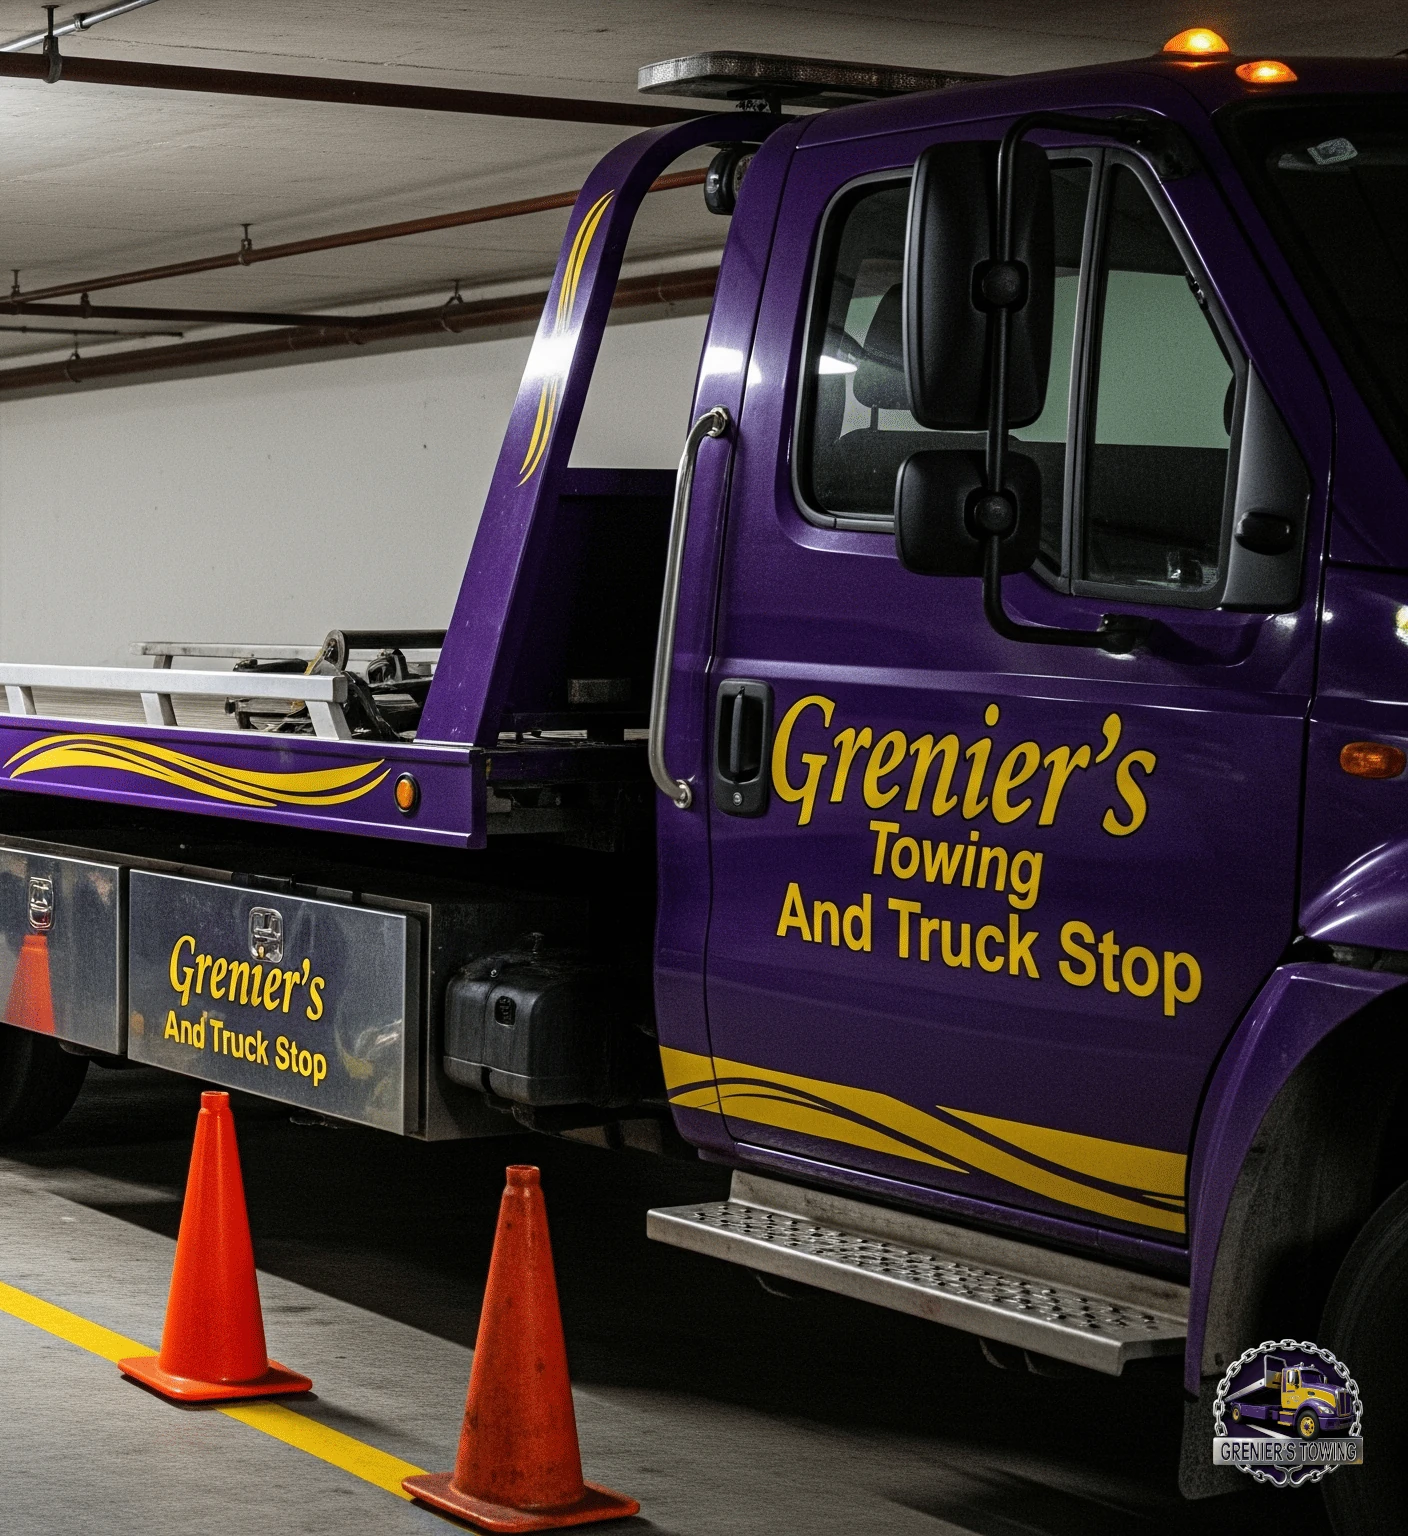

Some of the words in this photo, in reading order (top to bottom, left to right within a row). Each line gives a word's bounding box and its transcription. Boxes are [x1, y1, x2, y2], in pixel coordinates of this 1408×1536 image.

[770, 694, 1158, 837] Grenier's
[868, 819, 1044, 911] Towing
[168, 934, 327, 1022] Grenier's
[775, 882, 873, 953] And
[887, 897, 1041, 979] Truck
[1058, 919, 1203, 1018] Stop
[163, 1009, 206, 1051] And
[209, 1018, 270, 1066] Truck
[274, 1035, 328, 1088] Stop
